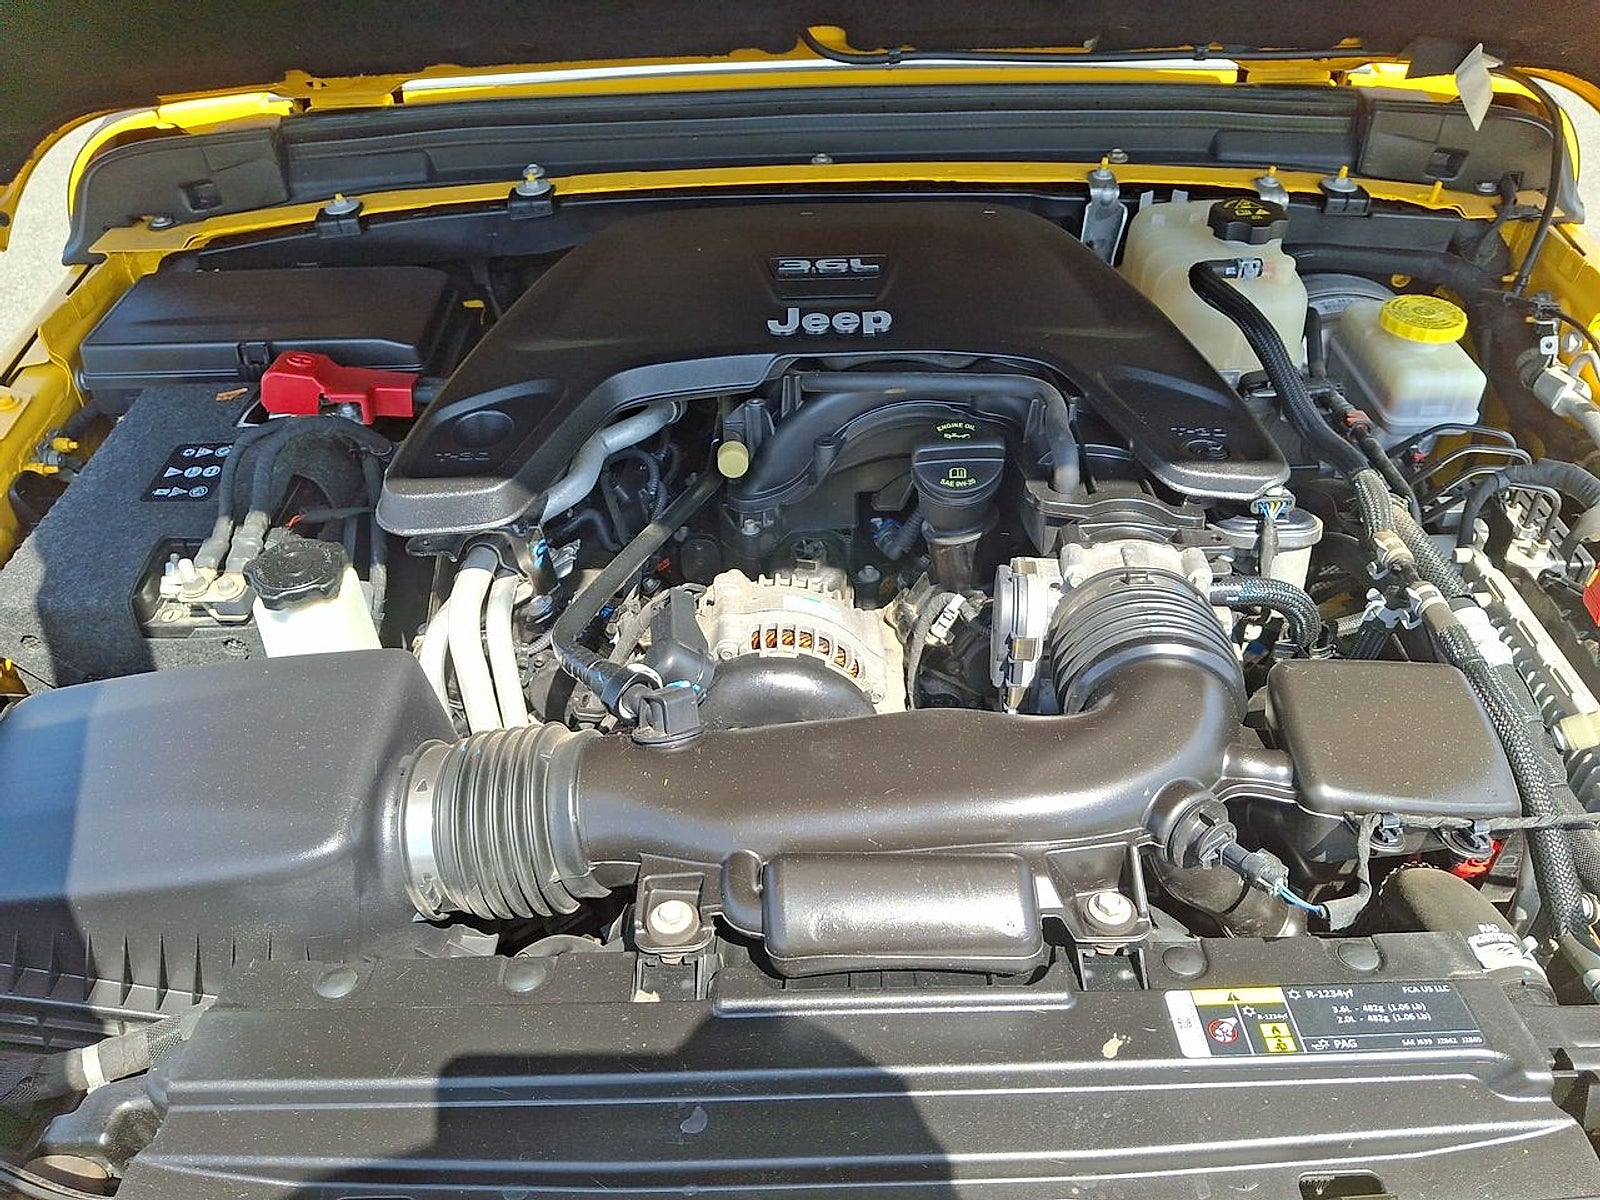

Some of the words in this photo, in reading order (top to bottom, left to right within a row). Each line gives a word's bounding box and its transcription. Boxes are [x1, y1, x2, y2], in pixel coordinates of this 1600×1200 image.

[778, 258, 879, 274] 3.6L
[767, 307, 893, 336] Jeep
[936, 423, 964, 431] ENGINE
[964, 423, 976, 431] OIL
[940, 479, 955, 487] SAE
[1419, 985, 1434, 993] US
[1434, 984, 1451, 993] LLC
[1305, 989, 1353, 999] R-1234yf
[1332, 1005, 1353, 1014] 3.6L
[1362, 1003, 1385, 1013] 482g
[1388, 1003, 1411, 1012] (1.06
[1336, 1015, 1357, 1024] 2.0L
[1367, 1013, 1390, 1023] 482g
[1392, 1013, 1415, 1022] (1.06
[1333, 1039, 1358, 1049] PAG
